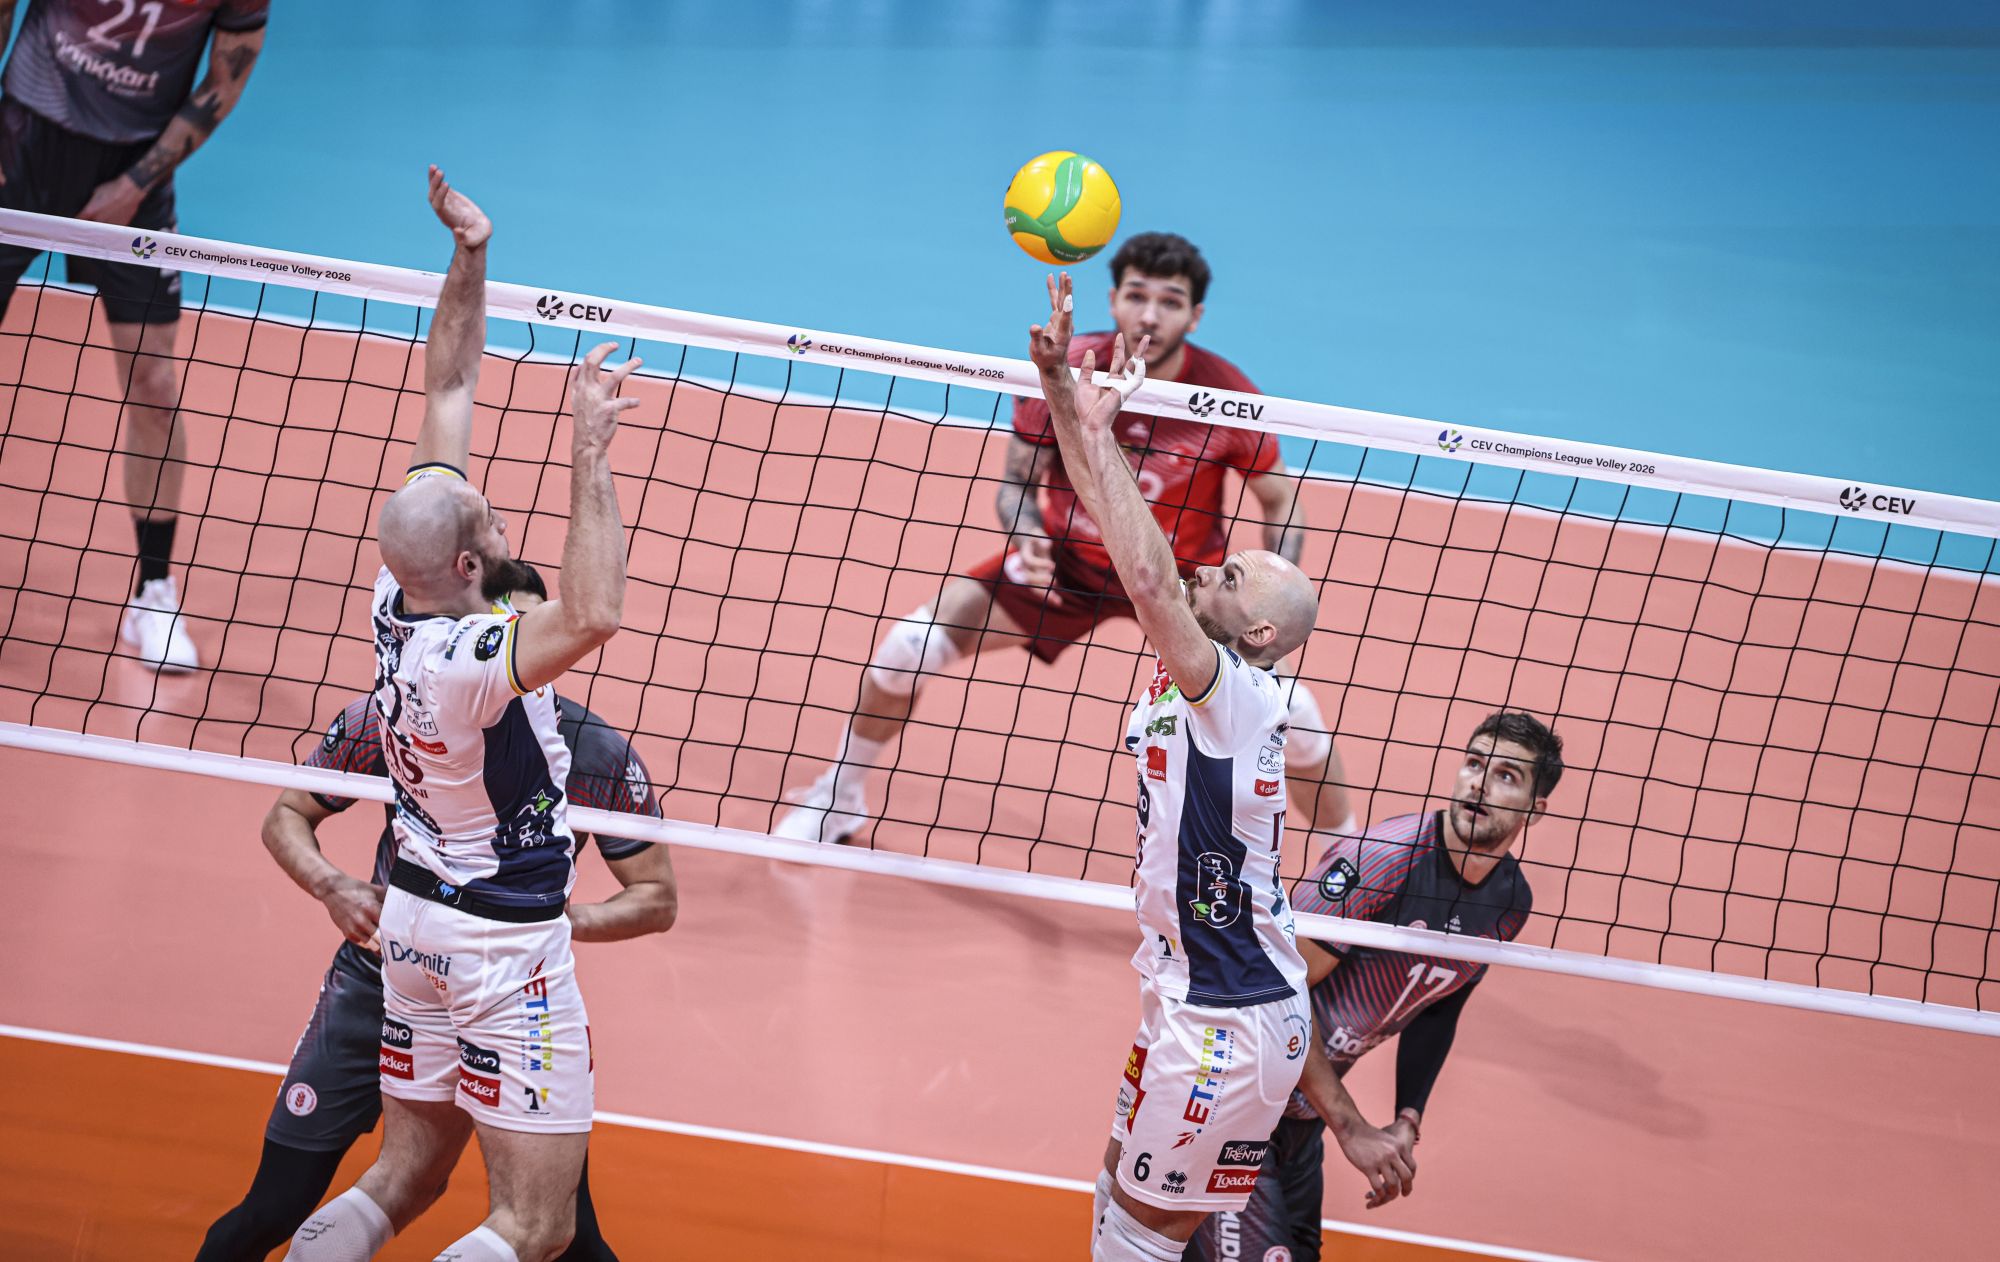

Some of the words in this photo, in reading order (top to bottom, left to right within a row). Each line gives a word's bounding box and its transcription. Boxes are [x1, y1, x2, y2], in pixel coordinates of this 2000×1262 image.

[87, 0, 163, 57] 21
[165, 246, 188, 257] CEV
[189, 250, 248, 266] Champions
[250, 258, 289, 272] League
[291, 264, 323, 279] Volley
[325, 270, 352, 282] 2026
[569, 303, 613, 323] CEV
[820, 343, 843, 354] CEV
[844, 347, 902, 363] Champions
[904, 356, 943, 371] League
[945, 363, 977, 376] Volley
[979, 368, 1005, 379] 2026
[1220, 400, 1264, 421] CEV
[1470, 439, 1493, 451] CEV
[1495, 443, 1553, 460] Champions
[1555, 451, 1593, 466] League
[1595, 457, 1627, 472] Volley
[1629, 462, 1656, 474] 2026
[1872, 495, 1916, 515] CEV
[478, 632, 489, 649] CEV
[1340, 862, 1355, 877] CEV
[1382, 962, 1458, 1024] 17
[1195, 1026, 1215, 1085] ELETTRO
[1206, 1028, 1227, 1087] TEAM
[1183, 1084, 1214, 1125] ET
[1133, 1152, 1153, 1182] 6
